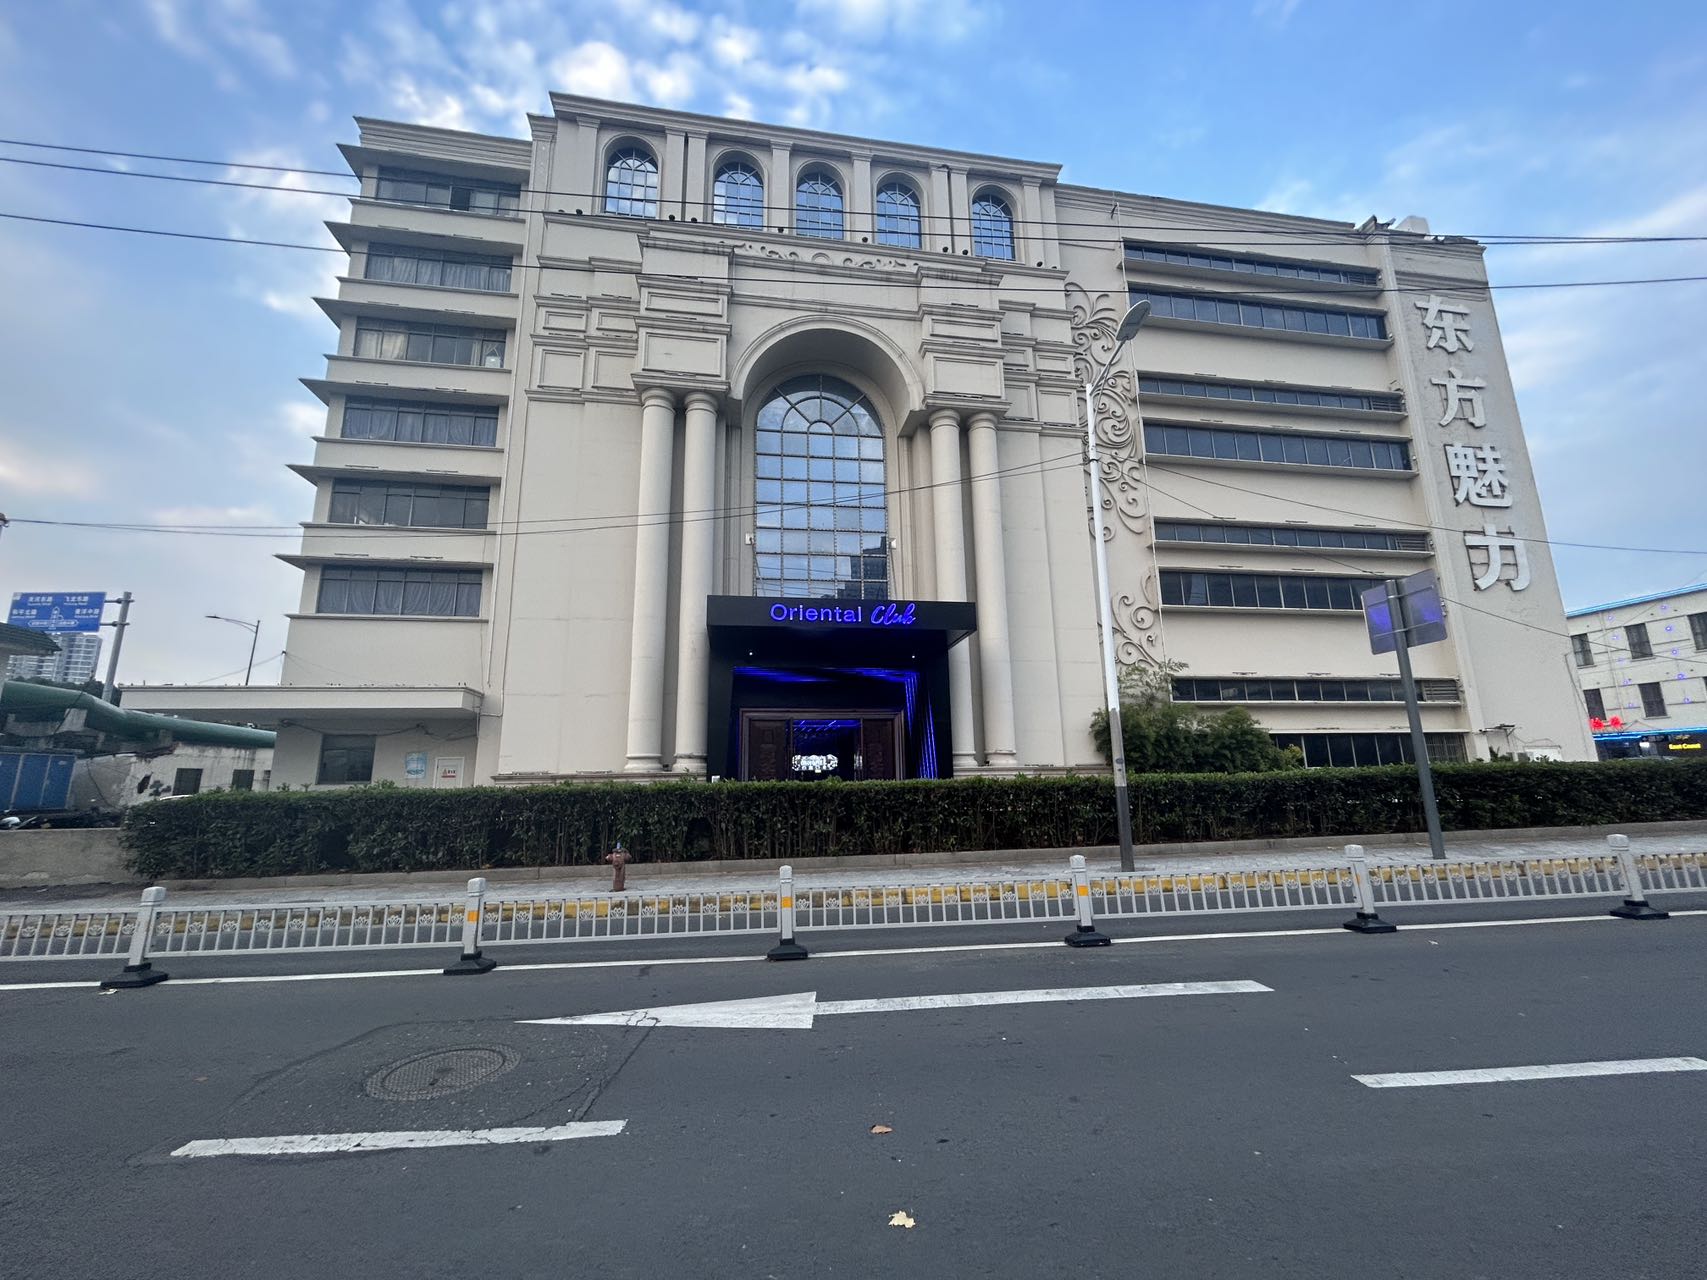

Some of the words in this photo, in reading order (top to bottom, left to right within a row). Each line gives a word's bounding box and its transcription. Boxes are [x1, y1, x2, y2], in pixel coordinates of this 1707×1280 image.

[1414, 294, 1532, 592] 东方魅力
[770, 603, 862, 622] Oriental
[870, 602, 916, 625] Club
